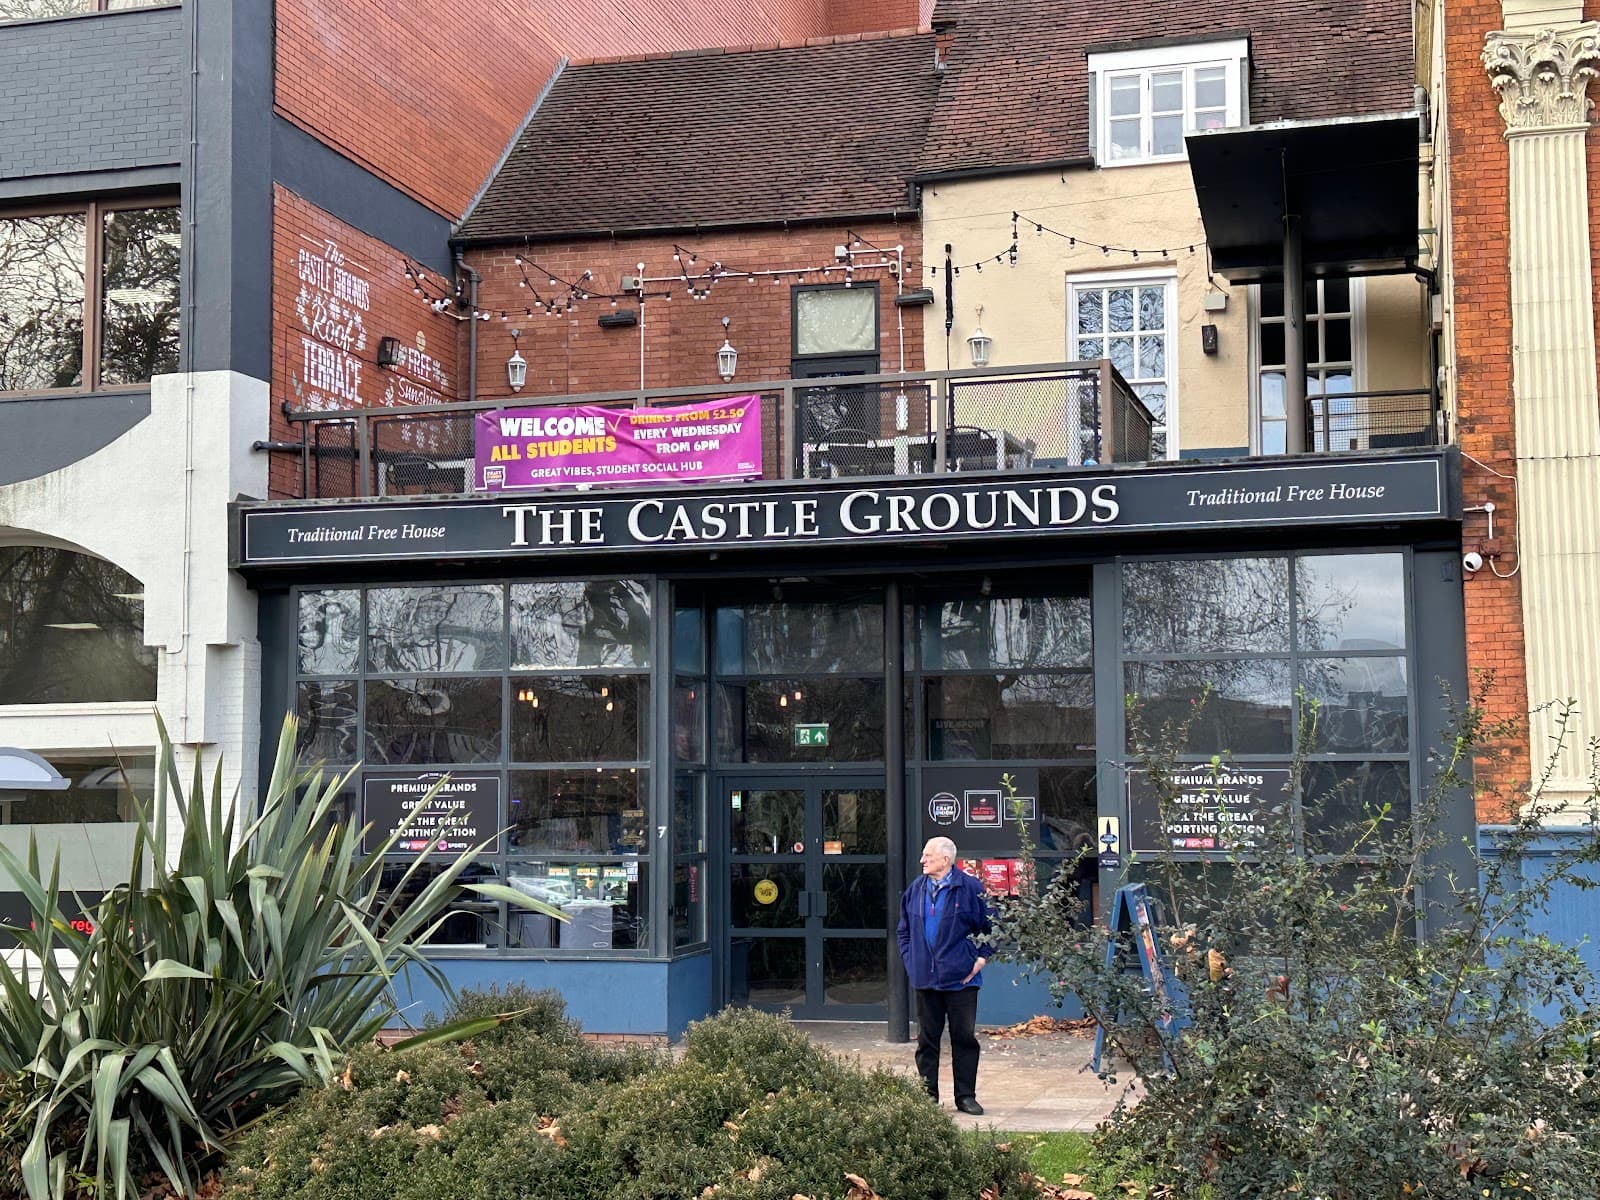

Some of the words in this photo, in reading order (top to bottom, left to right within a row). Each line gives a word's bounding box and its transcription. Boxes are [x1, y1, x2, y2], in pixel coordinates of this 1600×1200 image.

[324, 239, 345, 266] The
[299, 249, 331, 294] CASTLE
[333, 267, 370, 312] GROUNDS
[311, 304, 355, 356] Roof
[302, 338, 363, 404] TERRACE
[406, 347, 432, 379] FREE
[630, 414, 673, 424] DRINKS
[676, 411, 710, 422] FROM
[713, 408, 745, 420] £2.50
[500, 416, 606, 437] WELCOME
[634, 428, 667, 440] EVERY
[671, 423, 742, 437] WEDNESDAY
[491, 443, 521, 462] ALL
[526, 436, 617, 459] STUDENTS
[656, 442, 691, 454] FROM
[694, 440, 720, 452] 6PM
[531, 468, 562, 478] GREAT
[563, 466, 595, 477] VIBES,
[596, 464, 641, 475] STUDENT
[642, 462, 679, 473] SOCIAL
[680, 461, 703, 471] HUB
[1186, 487, 1281, 506] Traditional
[1287, 485, 1324, 502] Free
[1329, 483, 1385, 499] House
[502, 505, 605, 546] THE
[627, 499, 820, 543] CASTLE
[839, 484, 1120, 534] GROUNDS
[287, 526, 363, 543] Traditional
[368, 526, 398, 540] Free
[401, 524, 446, 539] House
[391, 784, 436, 793] PREMIUM
[1170, 775, 1213, 785] EMIUM
[402, 801, 433, 810] GRET
[435, 801, 466, 809] VALUE
[1212, 794, 1250, 804] VALUE
[417, 818, 435, 826] THE
[1193, 812, 1214, 822] THE
[1218, 812, 1254, 822] GREAT
[389, 828, 437, 838] SORTING
[657, 826, 667, 839] 7
